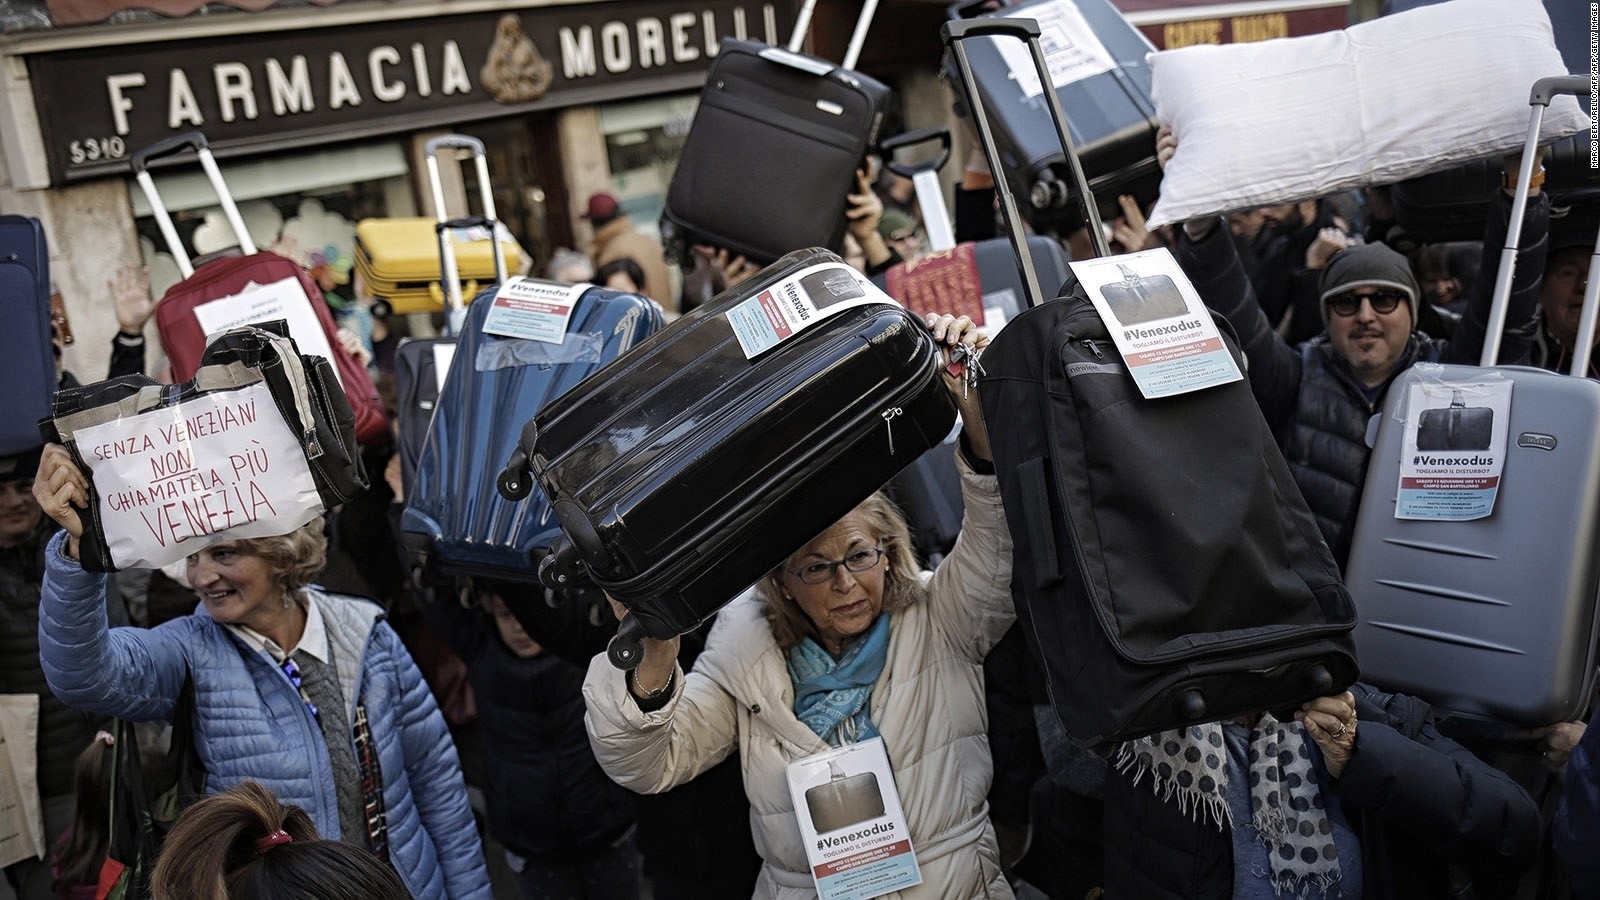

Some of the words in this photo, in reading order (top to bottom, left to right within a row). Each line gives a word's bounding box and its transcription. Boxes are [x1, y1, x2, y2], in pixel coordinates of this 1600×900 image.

[106, 39, 472, 136] FARMACIA
[70, 136, 125, 163] 5310
[1123, 319, 1202, 341] #Venexodus
[1133, 339, 1164, 349] TOGLIAMO
[94, 434, 156, 460] SENZA
[158, 398, 257, 444] VENEZIANI
[151, 448, 192, 479] NON
[1413, 455, 1493, 466] #Venexodus
[108, 468, 225, 513] CHIAMATELA
[229, 439, 269, 481] PIÙ
[140, 480, 277, 547] VENEZIA
[817, 822, 894, 851] #Venexodus
[823, 846, 855, 859] TOGLIAMO
[861, 834, 895, 847] DISTURBO?
